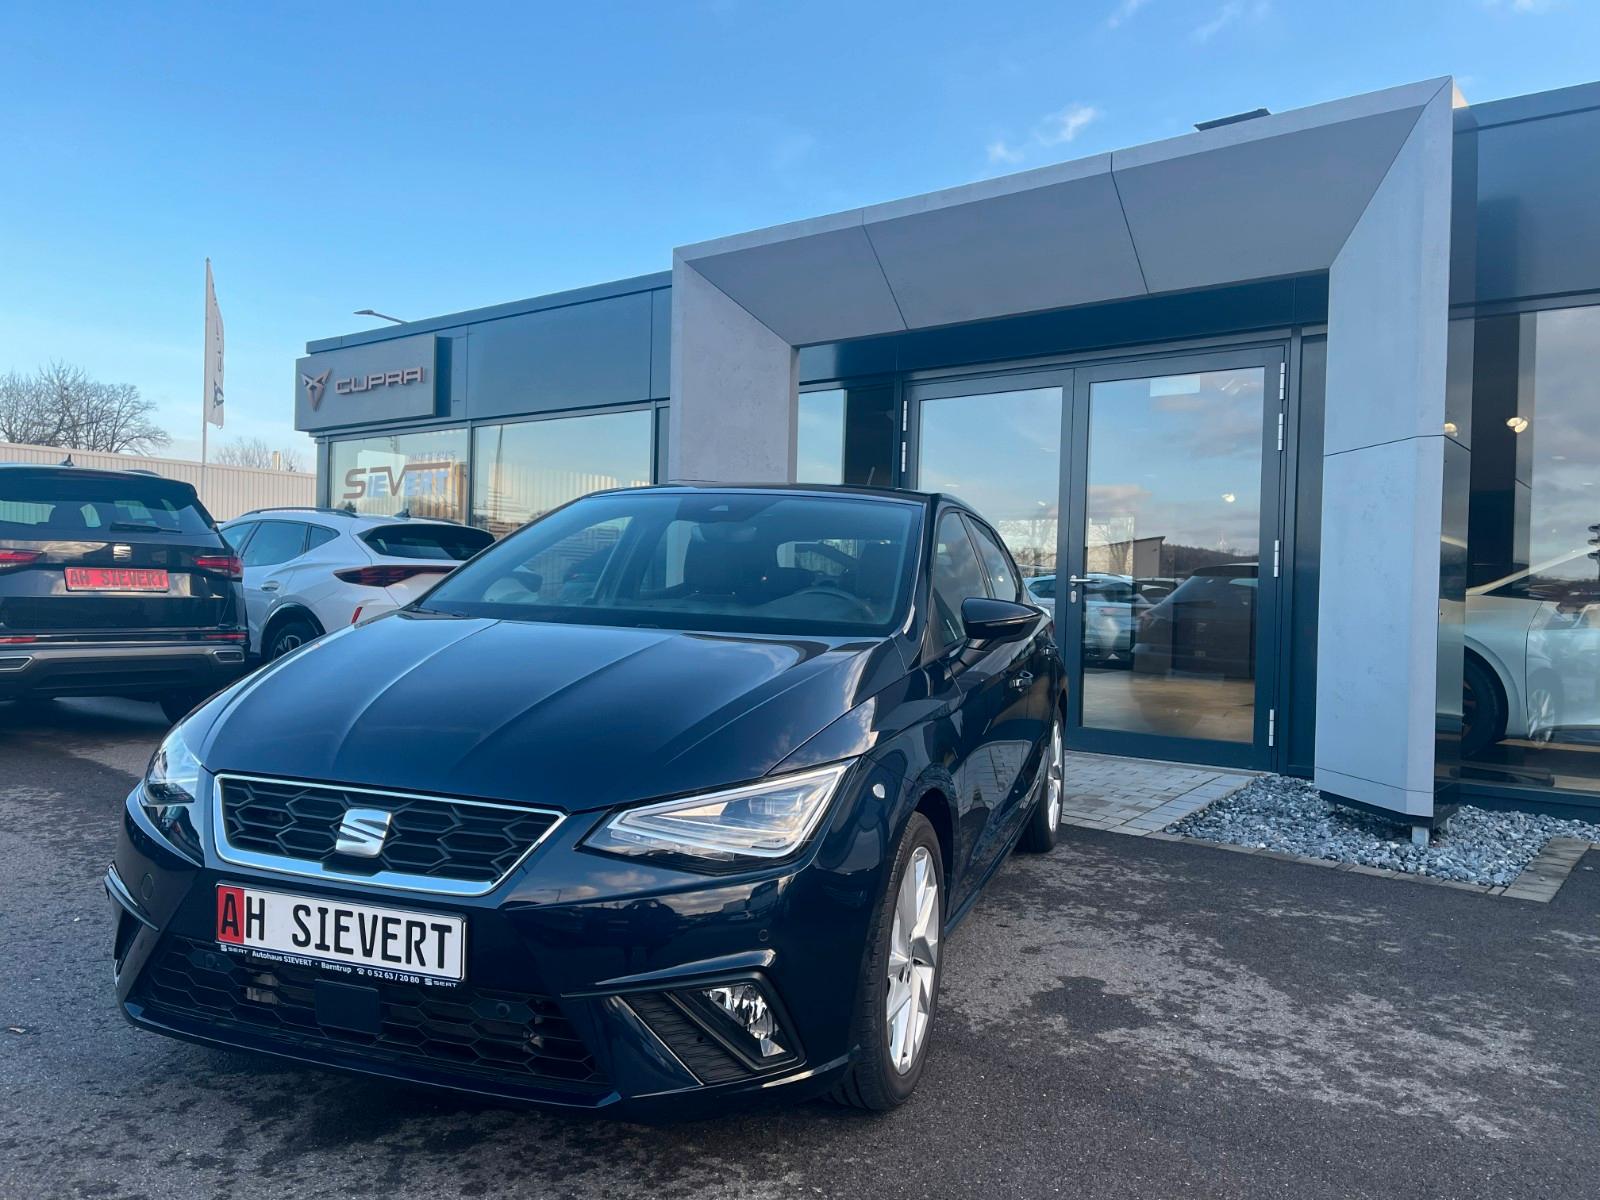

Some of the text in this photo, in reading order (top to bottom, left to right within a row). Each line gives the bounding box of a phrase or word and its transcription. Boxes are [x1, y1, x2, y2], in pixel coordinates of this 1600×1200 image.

[335, 367, 425, 394] CUPRA
[70, 569, 166, 586] AH SIEVERT
[221, 893, 452, 969] AH SIEVERT
[252, 950, 283, 962] Autohaus
[284, 956, 313, 967] SIEVERT
[321, 962, 352, 974] Barntrup
